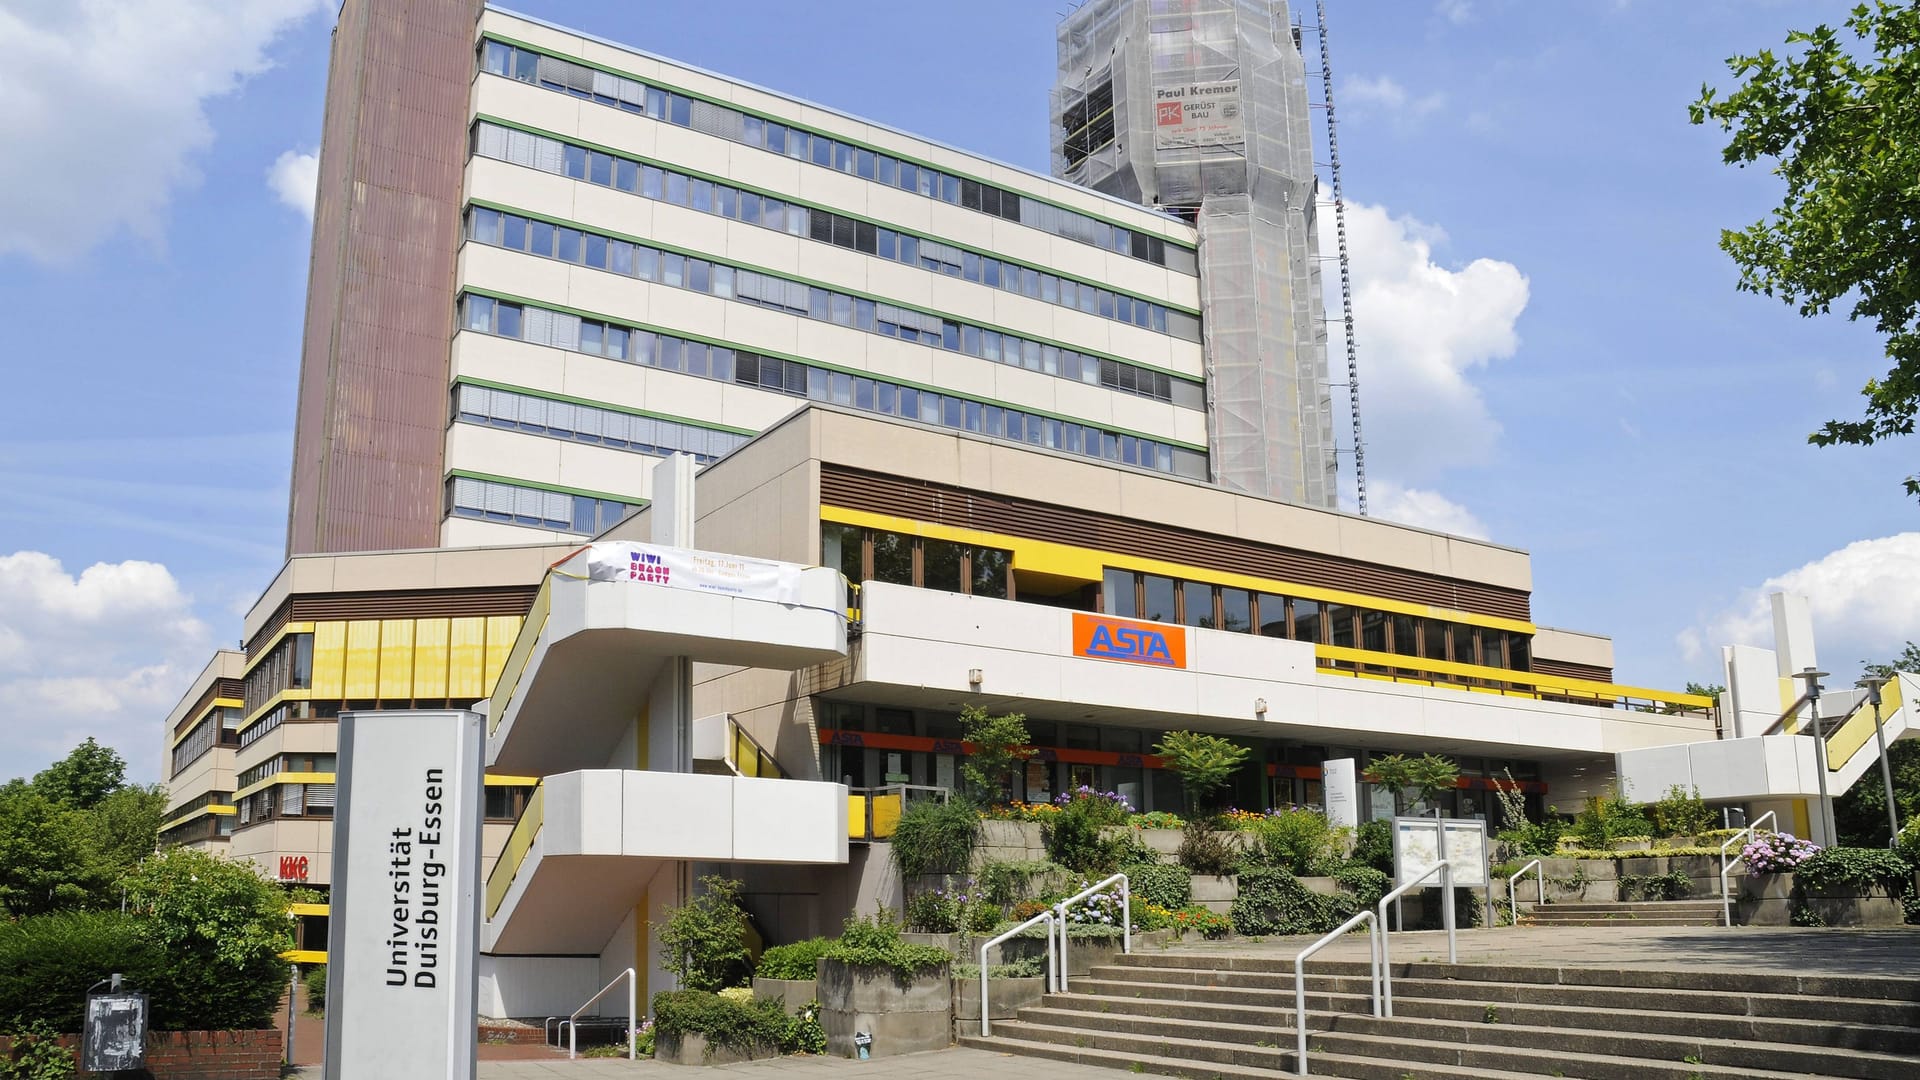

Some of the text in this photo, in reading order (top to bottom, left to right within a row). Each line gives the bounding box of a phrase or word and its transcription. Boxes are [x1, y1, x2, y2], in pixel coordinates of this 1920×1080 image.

[1157, 85, 1238, 99] Paul Kremer
[1184, 101, 1216, 111] GERÜST
[630, 551, 661, 565] WIWI
[630, 562, 670, 575] BEACH
[630, 571, 670, 584] PARTY
[1087, 624, 1173, 661] ASTA
[832, 730, 864, 746] ASTA
[279, 855, 308, 880] KKC
[414, 768, 446, 989] Duisburg-Essen
[386, 827, 412, 987] Universität
